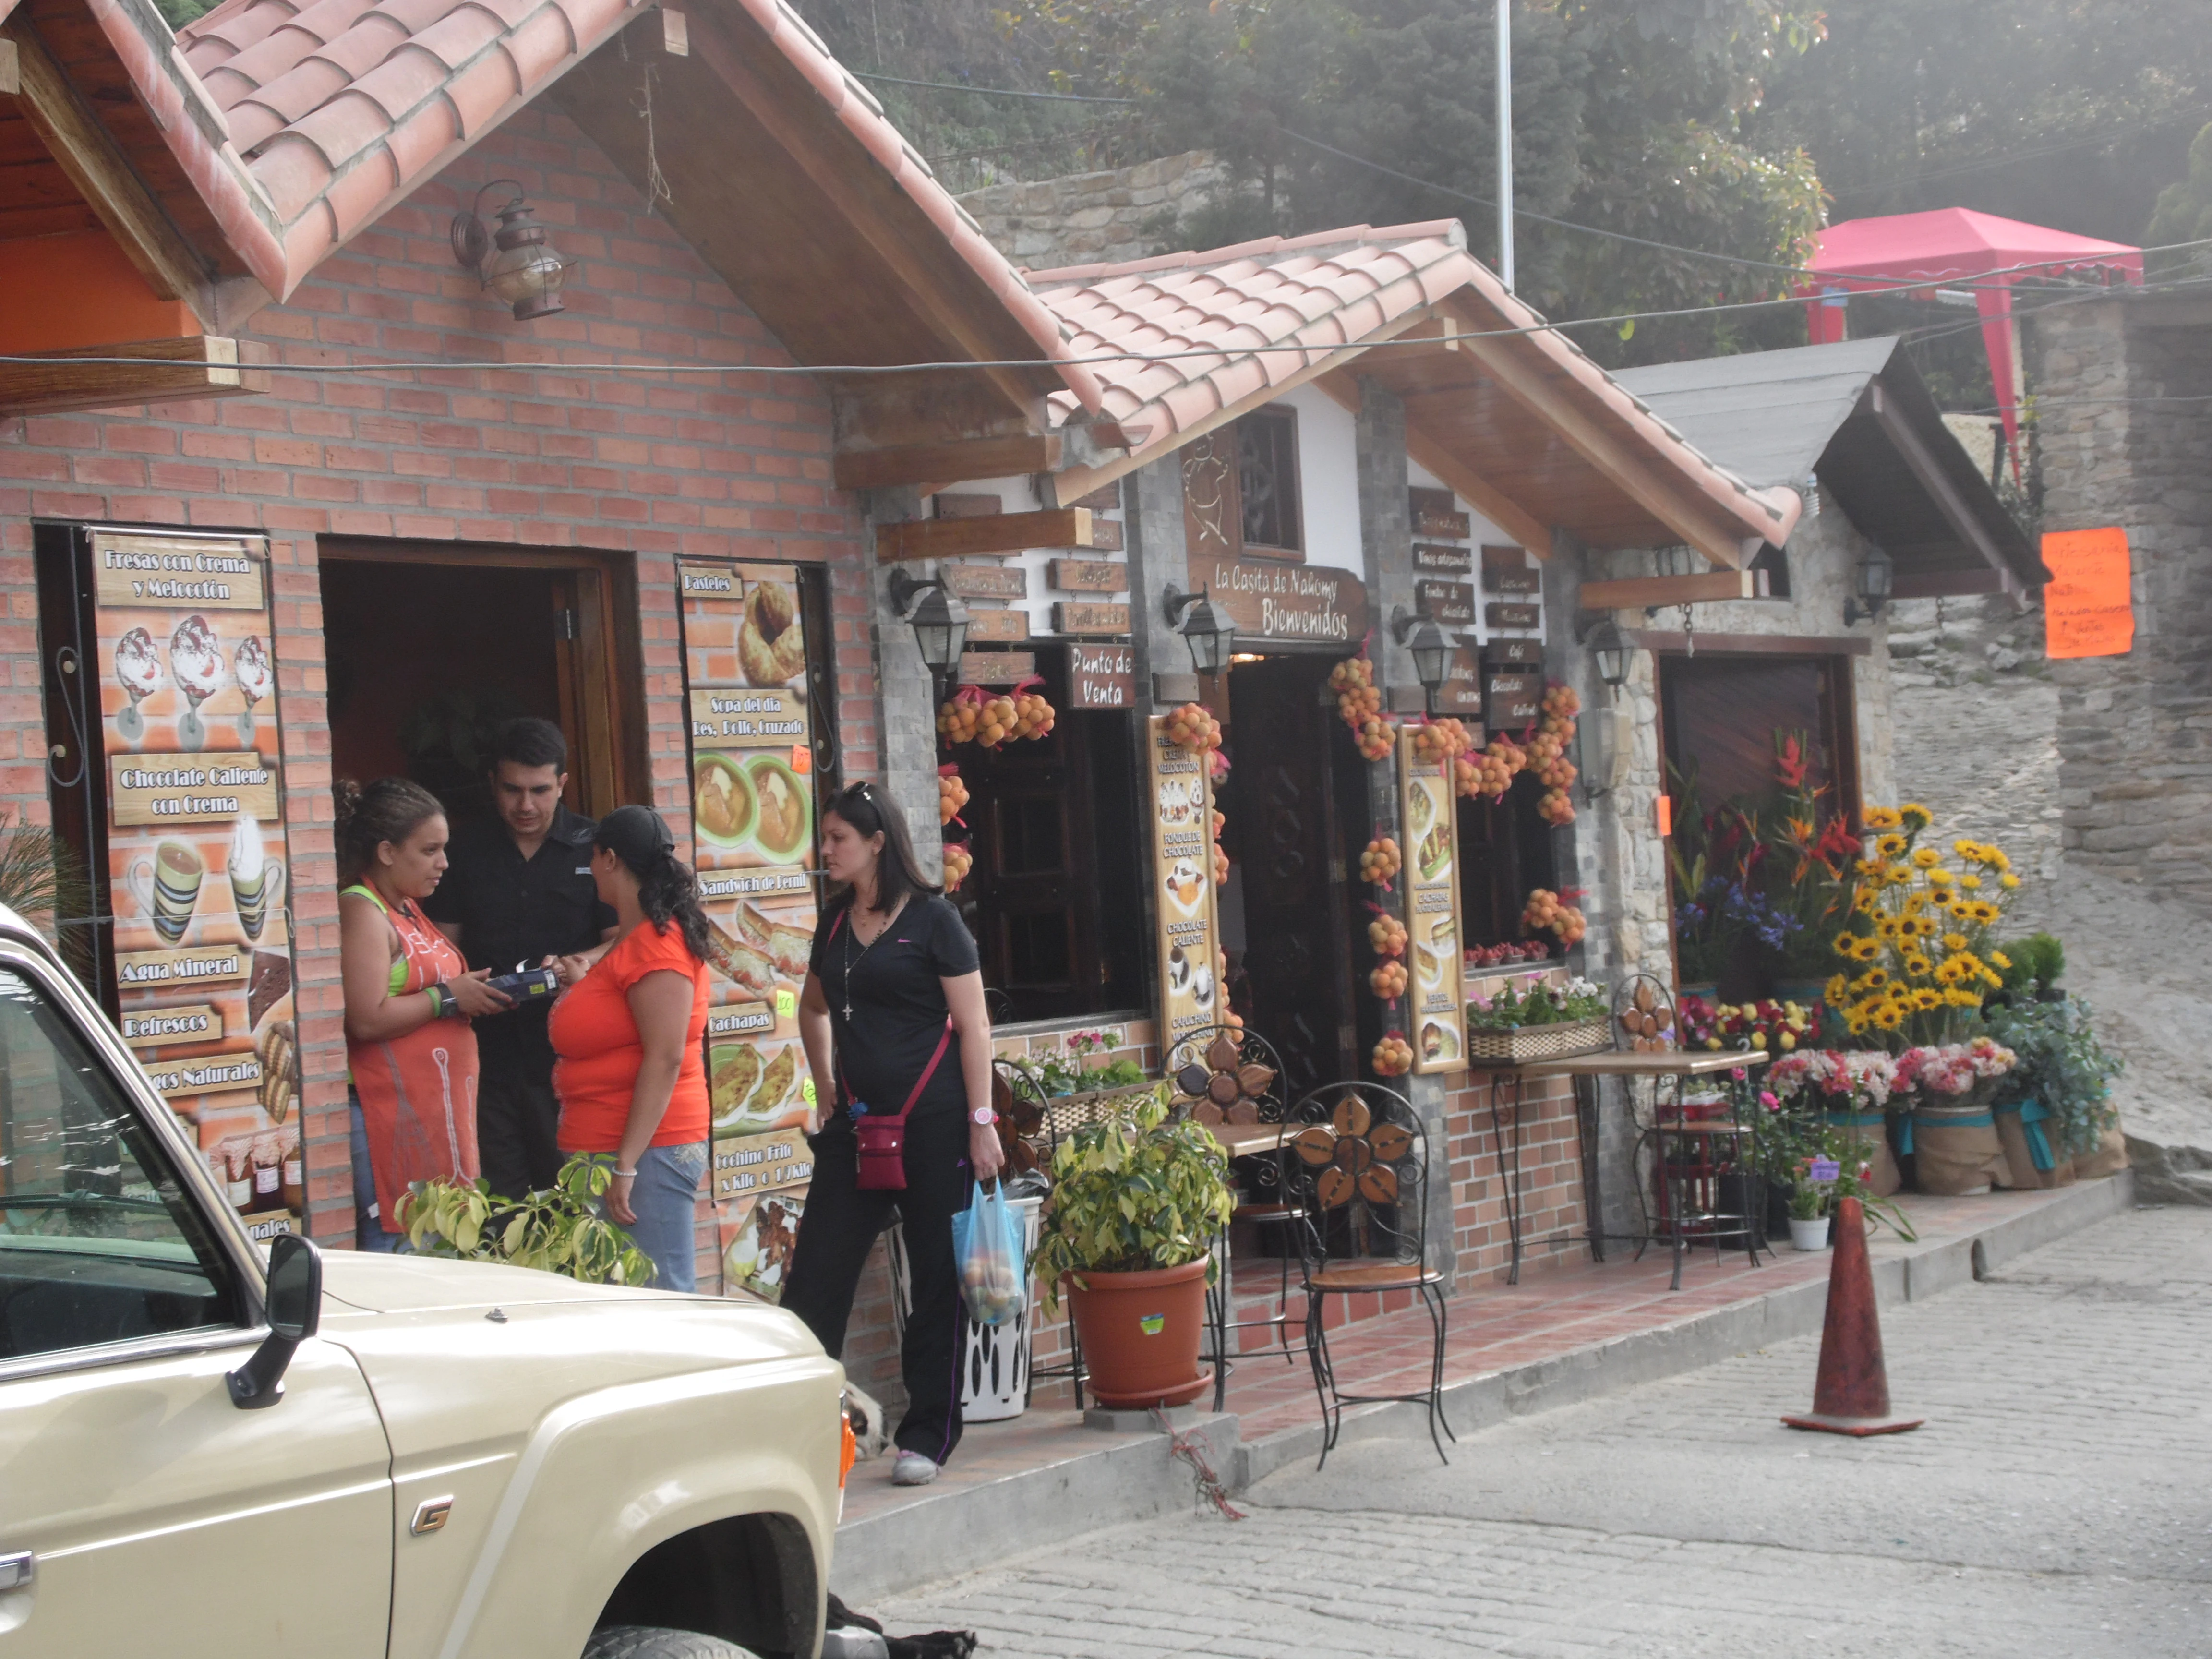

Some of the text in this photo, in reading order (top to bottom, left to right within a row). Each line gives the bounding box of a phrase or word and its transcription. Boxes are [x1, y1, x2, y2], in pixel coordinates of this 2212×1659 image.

[104, 549, 251, 573] Fresas con Crema
[132, 578, 231, 600] y Melocotón
[684, 575, 731, 592] Pasteles
[1215, 563, 1338, 604] La Casita de Nahomy
[1262, 597, 1348, 640] Bienvenidos
[1072, 648, 1132, 674] Punto de
[1083, 680, 1123, 705] Venta
[711, 697, 742, 713] Sopa
[743, 697, 761, 713] del
[693, 719, 804, 737] Res, Pollo, Cruzado
[120, 767, 269, 789] Chocolate Caliente
[151, 795, 239, 815] con Crema
[1163, 830, 1201, 844] FONDUE DE
[1163, 844, 1203, 858] CHOCOLATE
[699, 872, 806, 896] Sandwich de Pernil
[1167, 918, 1208, 934] CHOCOLATE
[1172, 933, 1204, 947] CALIENTE
[120, 954, 239, 983] Agua Mineral
[124, 1014, 208, 1038] Refrescos
[710, 1011, 770, 1033] Cachapas
[182, 1061, 260, 1087] Naturales
[715, 1143, 792, 1170] Cochino Frito
[721, 1178, 731, 1192] x
[733, 1172, 756, 1190] kilo
[762, 1171, 769, 1185] o
